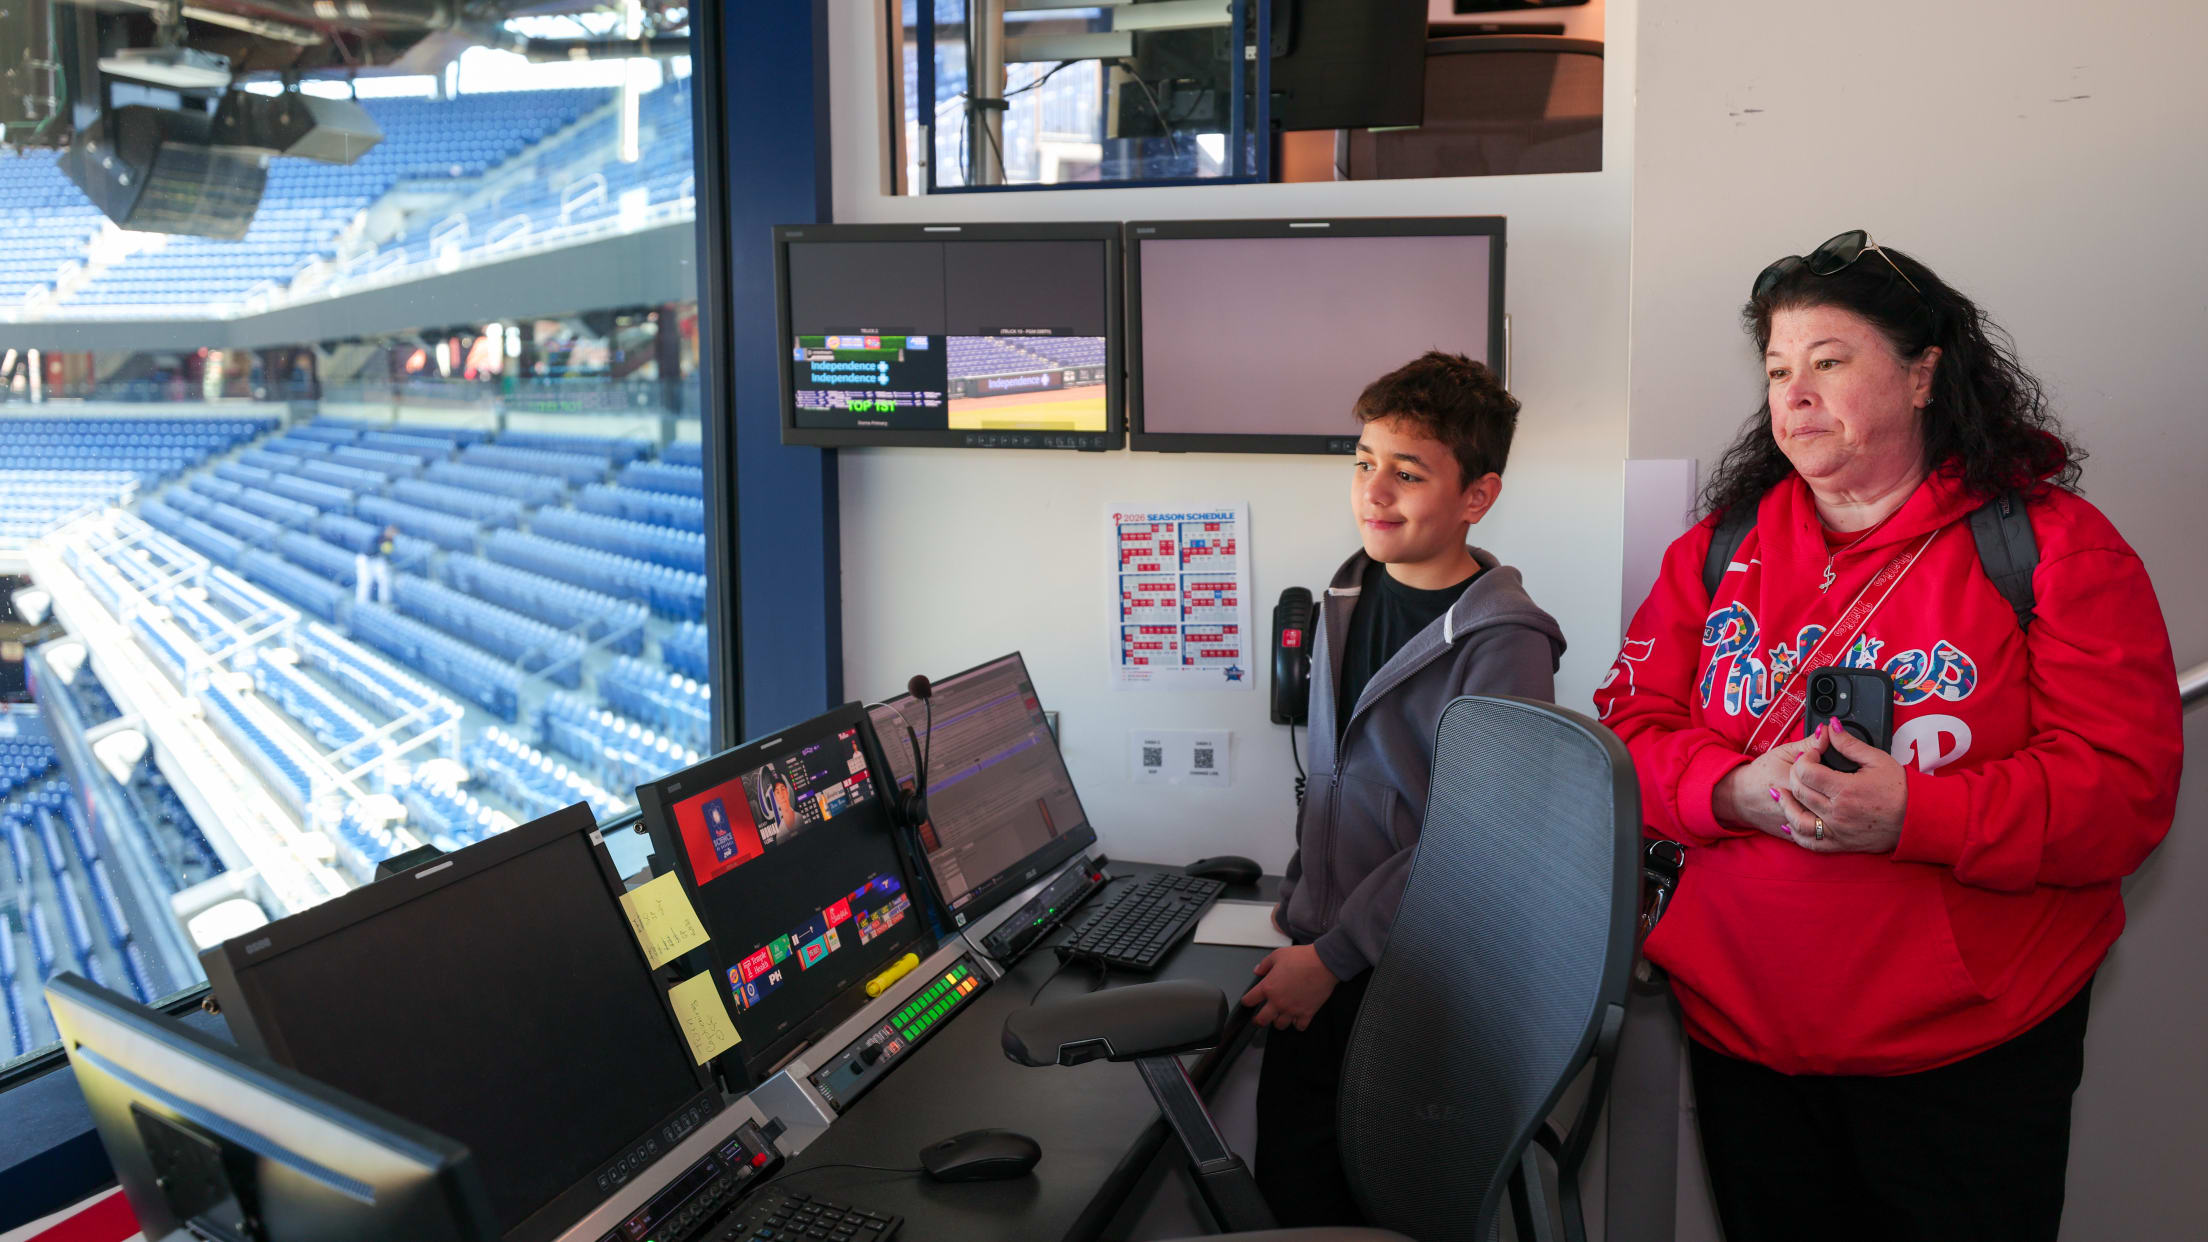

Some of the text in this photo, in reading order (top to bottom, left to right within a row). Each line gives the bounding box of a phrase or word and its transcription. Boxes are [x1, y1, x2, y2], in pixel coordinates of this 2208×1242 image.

[811, 361, 876, 372] Independence
[811, 373, 876, 384] Independence
[988, 376, 1041, 390] Independence
[848, 400, 897, 412] TOP 1ST
[1123, 514, 1145, 522] 2026
[1147, 513, 1184, 521] SEASON
[1186, 512, 1235, 520] SCHEDULE
[751, 951, 767, 965] Temple
[753, 961, 769, 975] Health
[768, 969, 783, 986] PH
